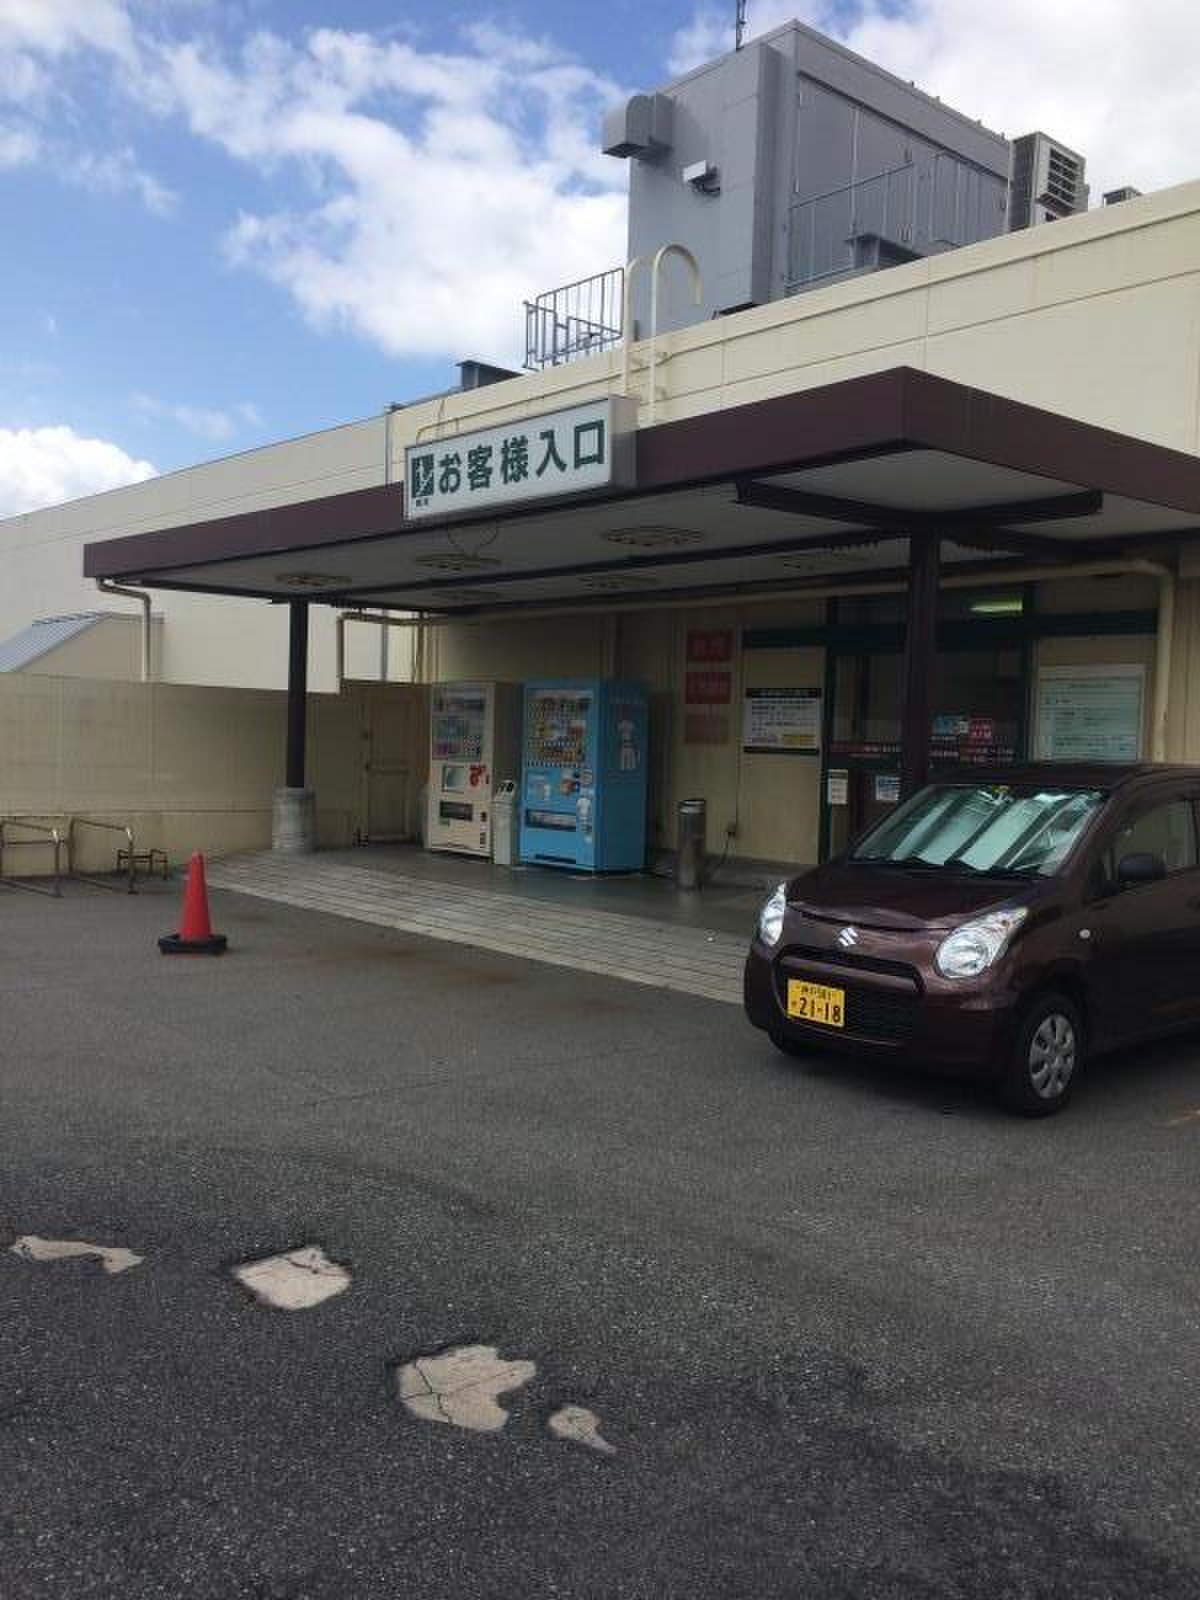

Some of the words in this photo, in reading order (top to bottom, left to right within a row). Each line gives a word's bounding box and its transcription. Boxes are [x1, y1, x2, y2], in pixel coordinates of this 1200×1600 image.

[438, 420, 605, 493] お客様入口
[799, 997, 841, 1023] 21-18
